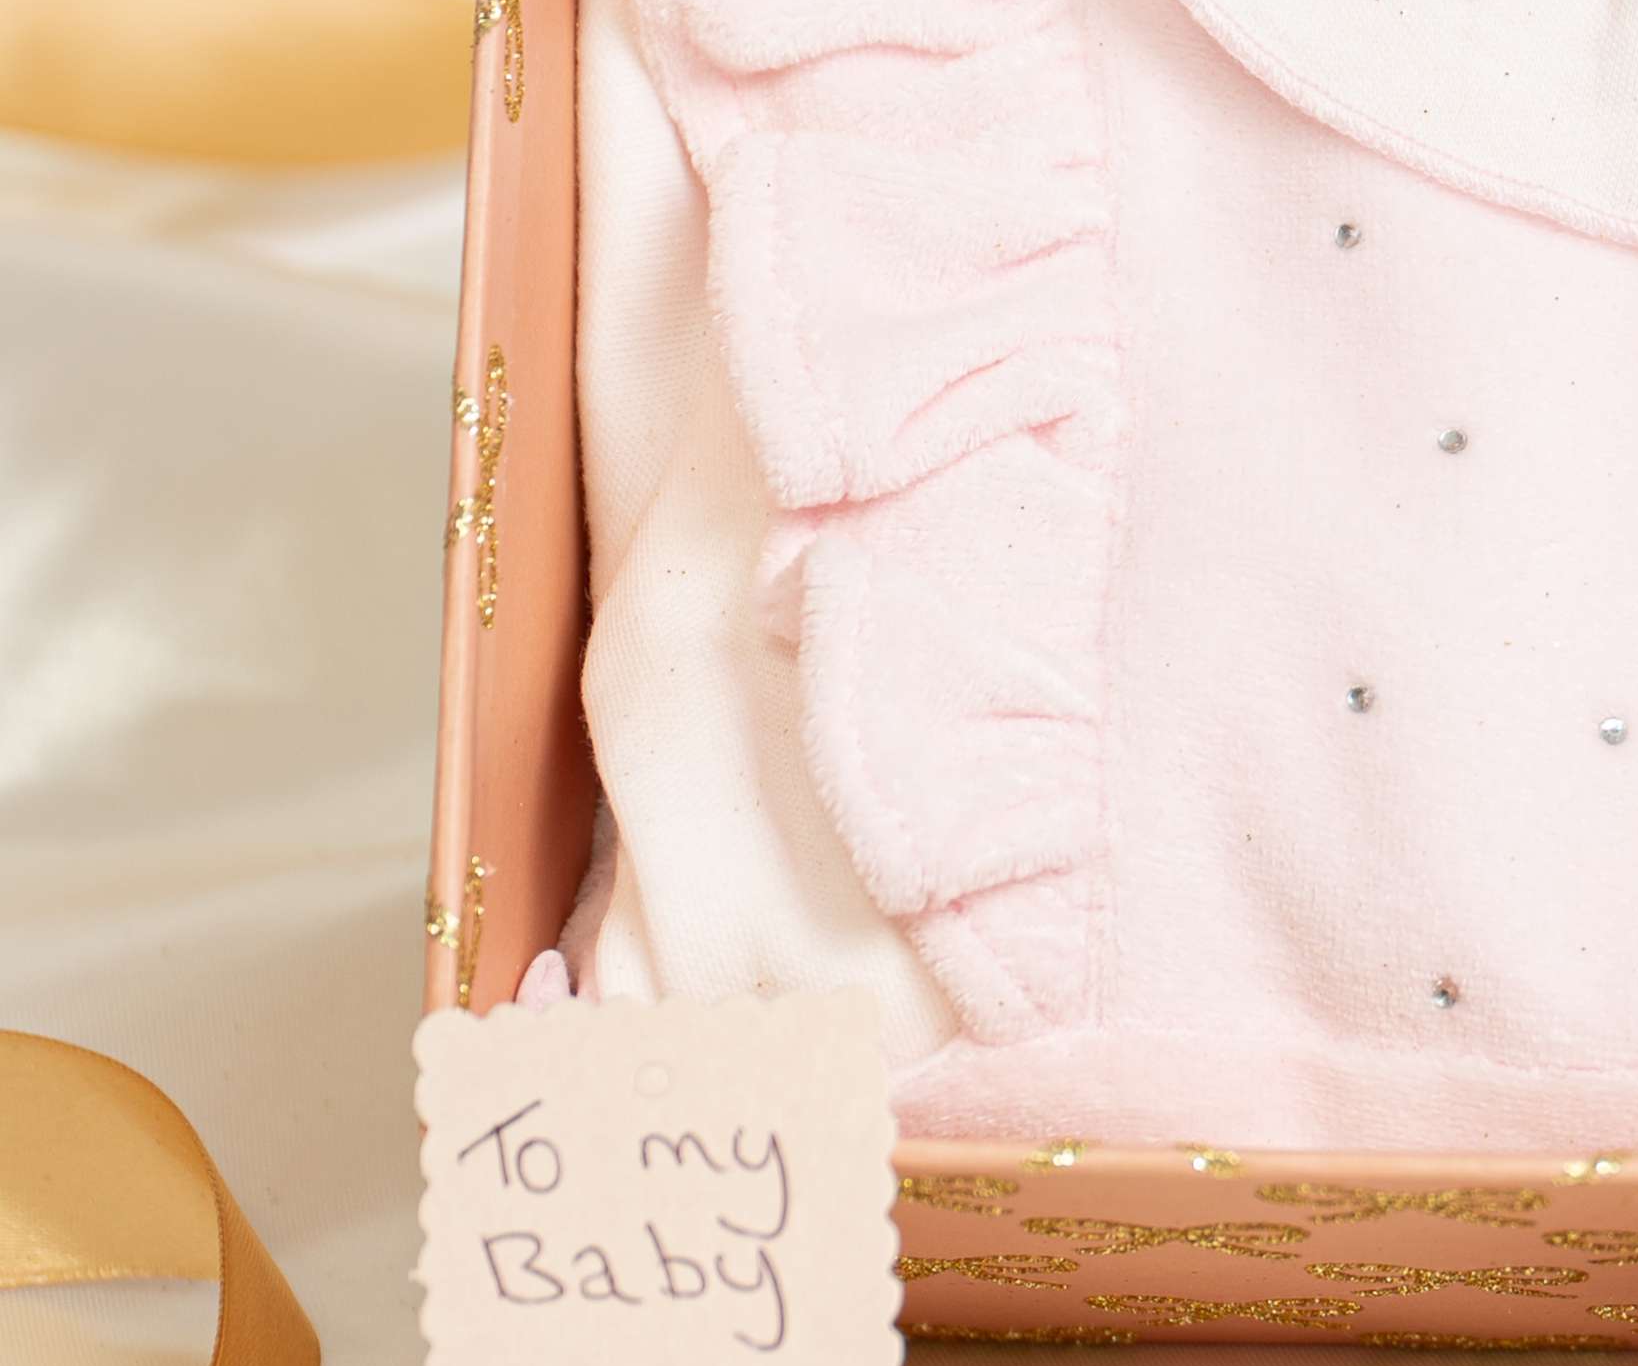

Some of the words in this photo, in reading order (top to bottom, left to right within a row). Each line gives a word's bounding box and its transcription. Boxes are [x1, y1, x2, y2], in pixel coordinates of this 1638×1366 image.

[457, 1099, 563, 1195] To
[640, 1126, 791, 1240] my
[483, 1221, 786, 1352] Baby
